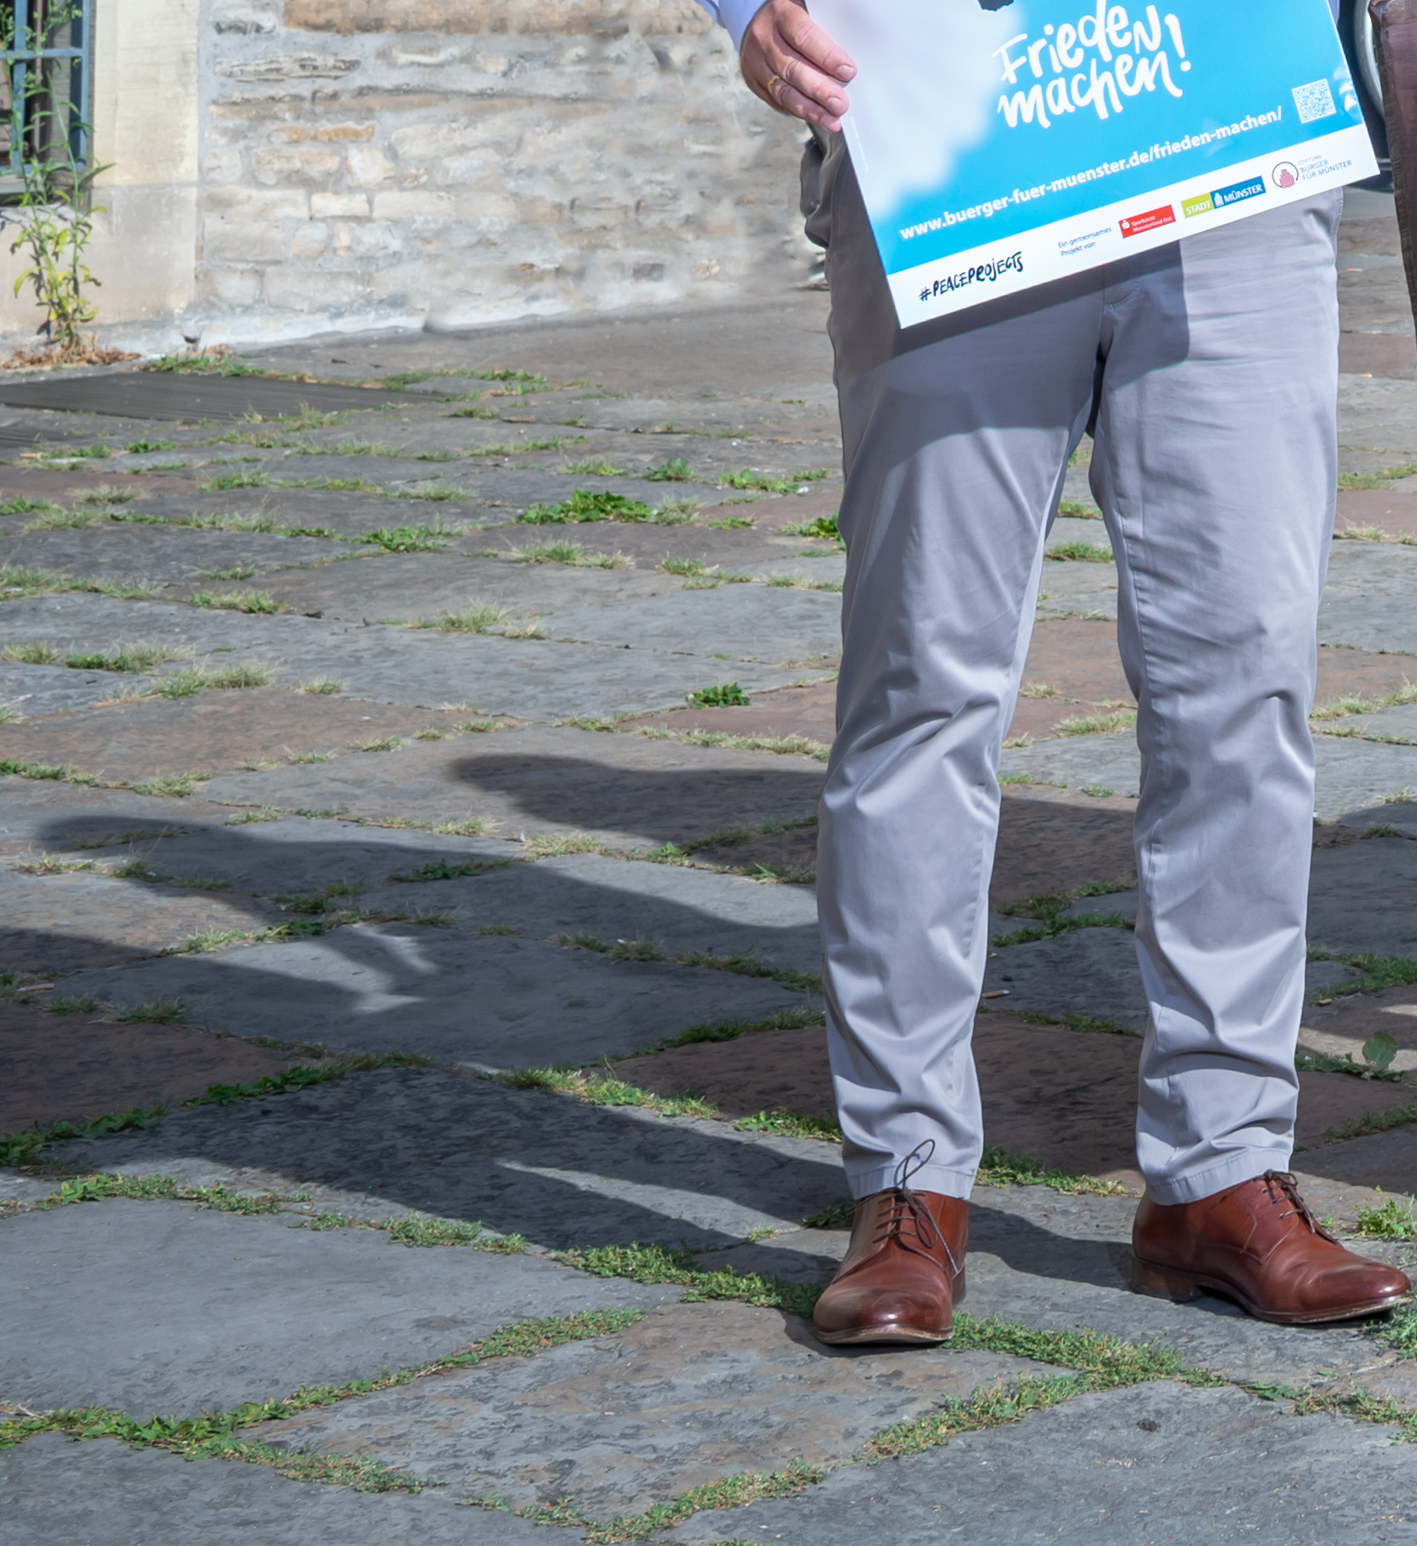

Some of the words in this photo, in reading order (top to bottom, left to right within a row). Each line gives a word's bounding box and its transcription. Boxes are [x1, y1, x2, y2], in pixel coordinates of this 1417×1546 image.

[997, 14, 1191, 129] machen!
[899, 105, 1283, 241] www.buerger-fuer-muenster.de/frieden-machen/
[1300, 159, 1329, 174] BÜRGER
[1302, 171, 1317, 181] FÜR
[1318, 159, 1353, 178] MÜNSTER
[1185, 200, 1211, 216] STADT
[1223, 183, 1263, 203] MÜNSTER
[1058, 239, 1068, 248] Ein
[1060, 245, 1082, 256] Projekt
[1083, 241, 1096, 250] von
